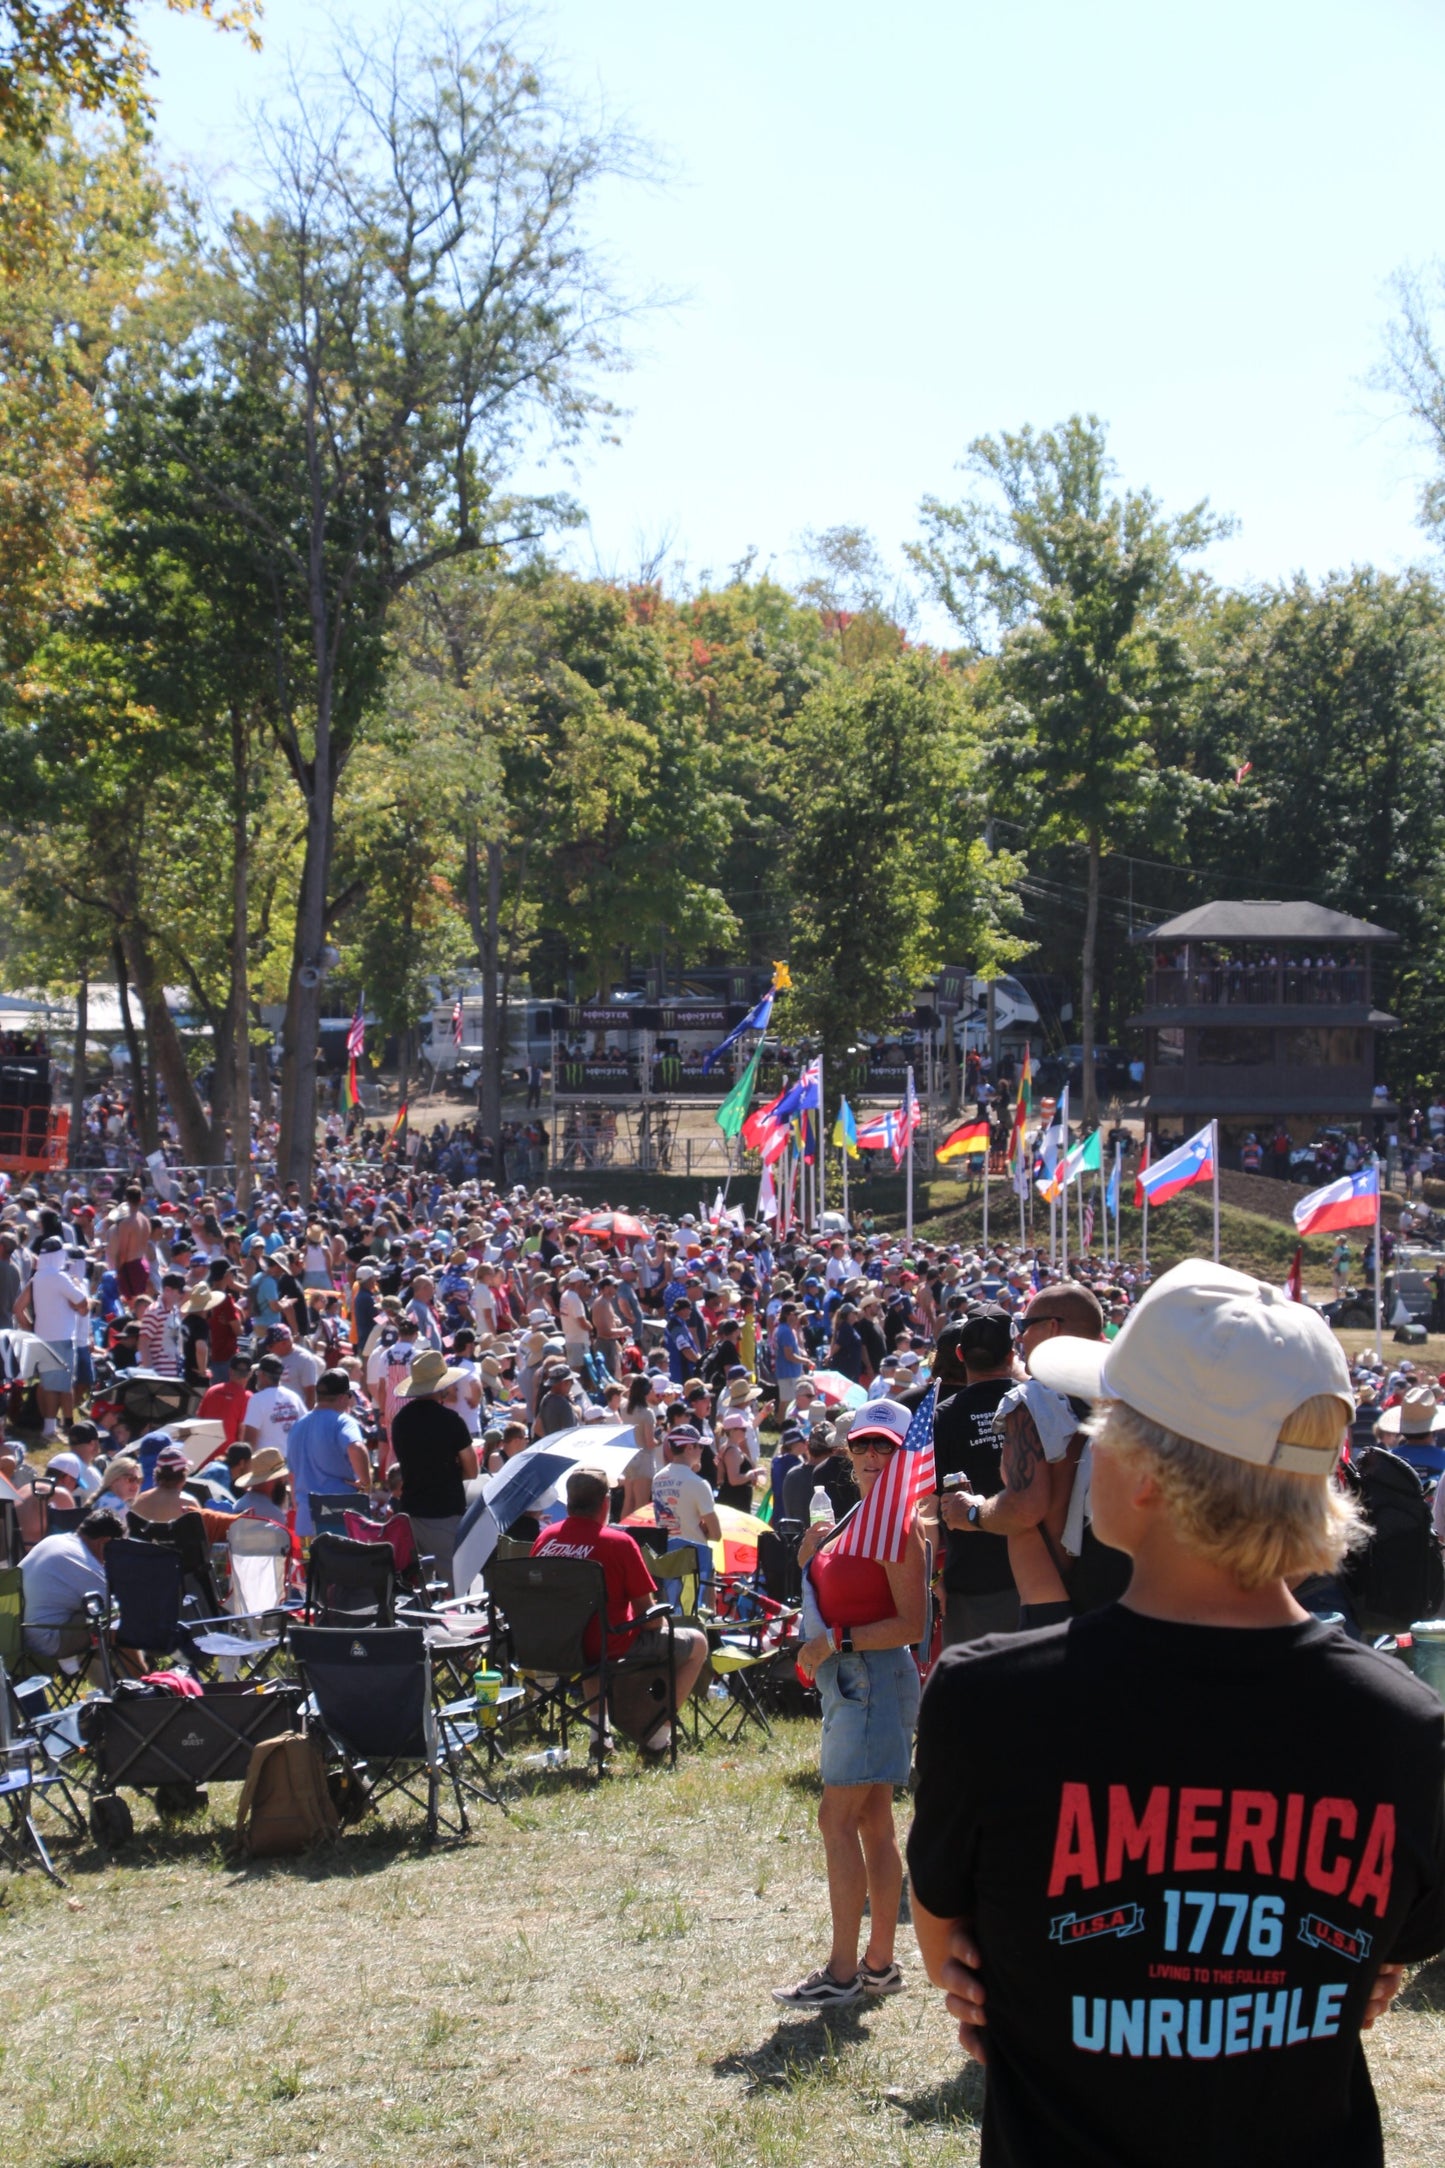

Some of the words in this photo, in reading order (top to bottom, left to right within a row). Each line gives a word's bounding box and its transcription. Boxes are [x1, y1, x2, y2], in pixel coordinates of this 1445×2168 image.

[583, 1011, 630, 1020] MONSTER
[677, 1012, 724, 1021] MONSTER
[586, 1067, 629, 1076] MONSTER
[682, 1067, 725, 1075] MONTER
[870, 1067, 908, 1075] MONSTE
[970, 1435, 996, 1446] Leaving
[1047, 1782, 1396, 1918] AMERICA
[1163, 1890, 1285, 1957] 1776
[1148, 1963, 1191, 1981] LIVING
[1194, 1967, 1210, 1983] TO
[1212, 1968, 1235, 1985] THE
[1236, 1968, 1286, 1985] FULLEST
[1072, 1984, 1348, 2059] UNRUEHLE
